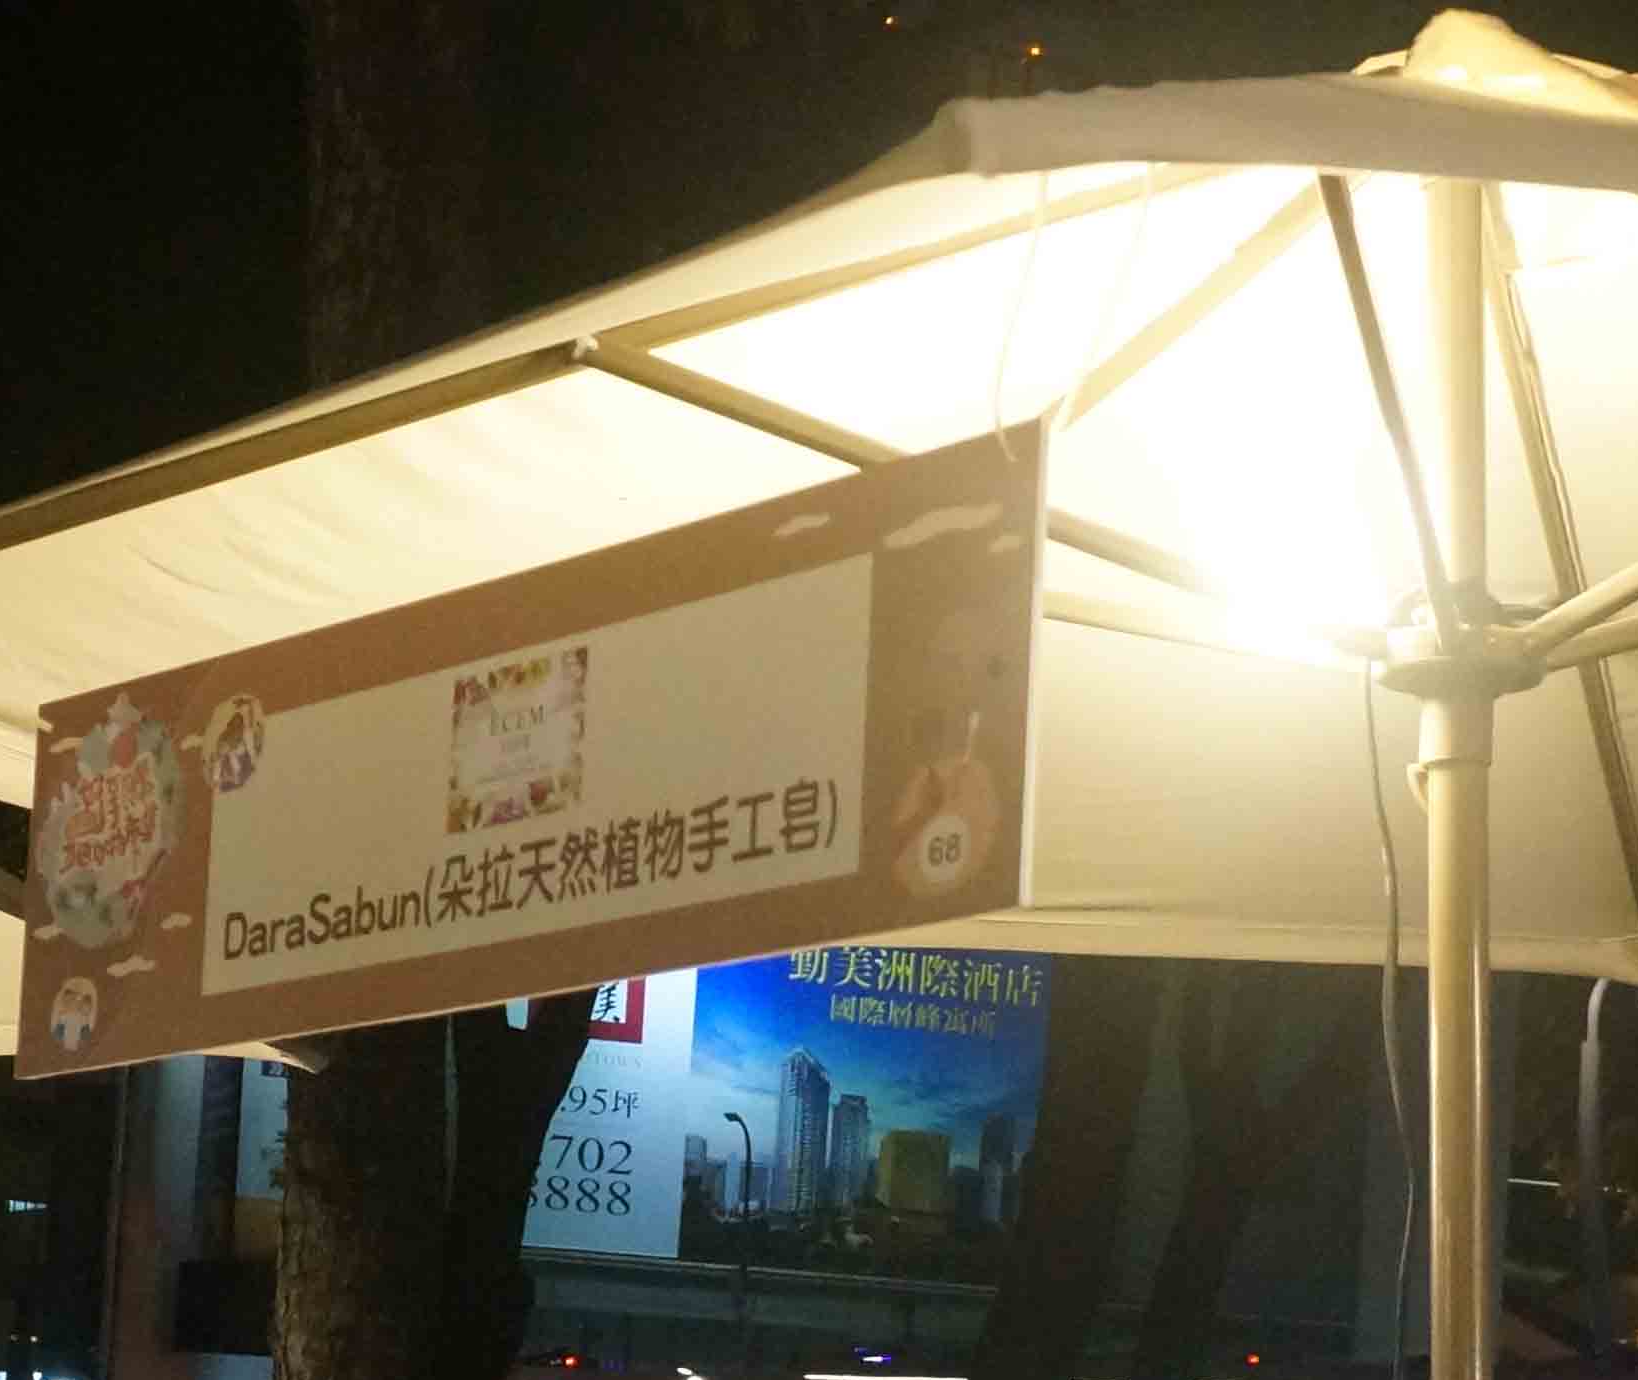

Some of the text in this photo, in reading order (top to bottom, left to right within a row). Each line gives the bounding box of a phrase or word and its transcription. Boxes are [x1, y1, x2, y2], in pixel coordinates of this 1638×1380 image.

[224, 778, 838, 960] DaraSabun(朵拉天然植物手工皂)
[927, 833, 963, 868] 68
